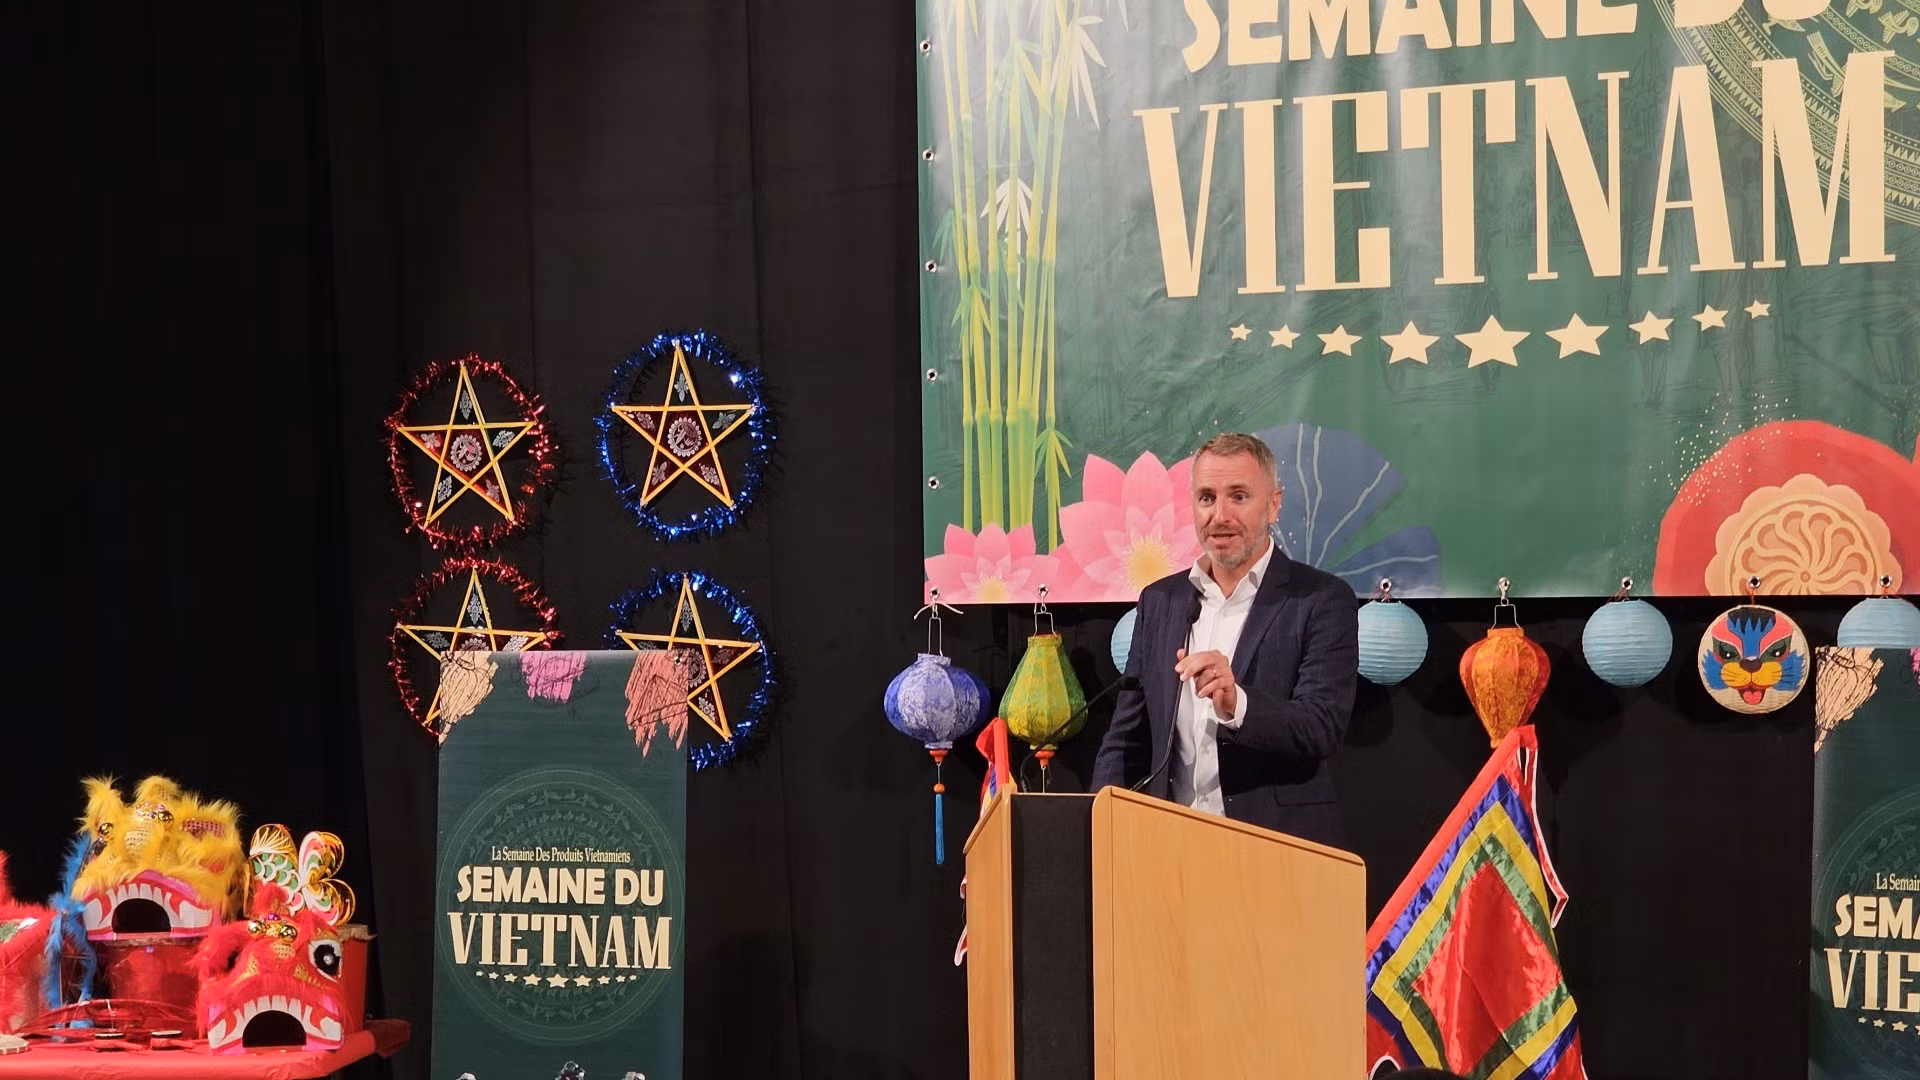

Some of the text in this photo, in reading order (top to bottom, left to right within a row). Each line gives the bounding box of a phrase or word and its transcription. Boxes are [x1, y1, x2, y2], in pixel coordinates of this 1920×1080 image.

[1133, 50, 1896, 299] VIETNAM
[491, 845, 631, 864] La Semaine Des Produits Vietnamiens
[456, 865, 664, 906] SEMAINE DU
[1875, 872, 1888, 890] La
[1834, 893, 1920, 940] SEM
[447, 911, 673, 970] VIETNAM
